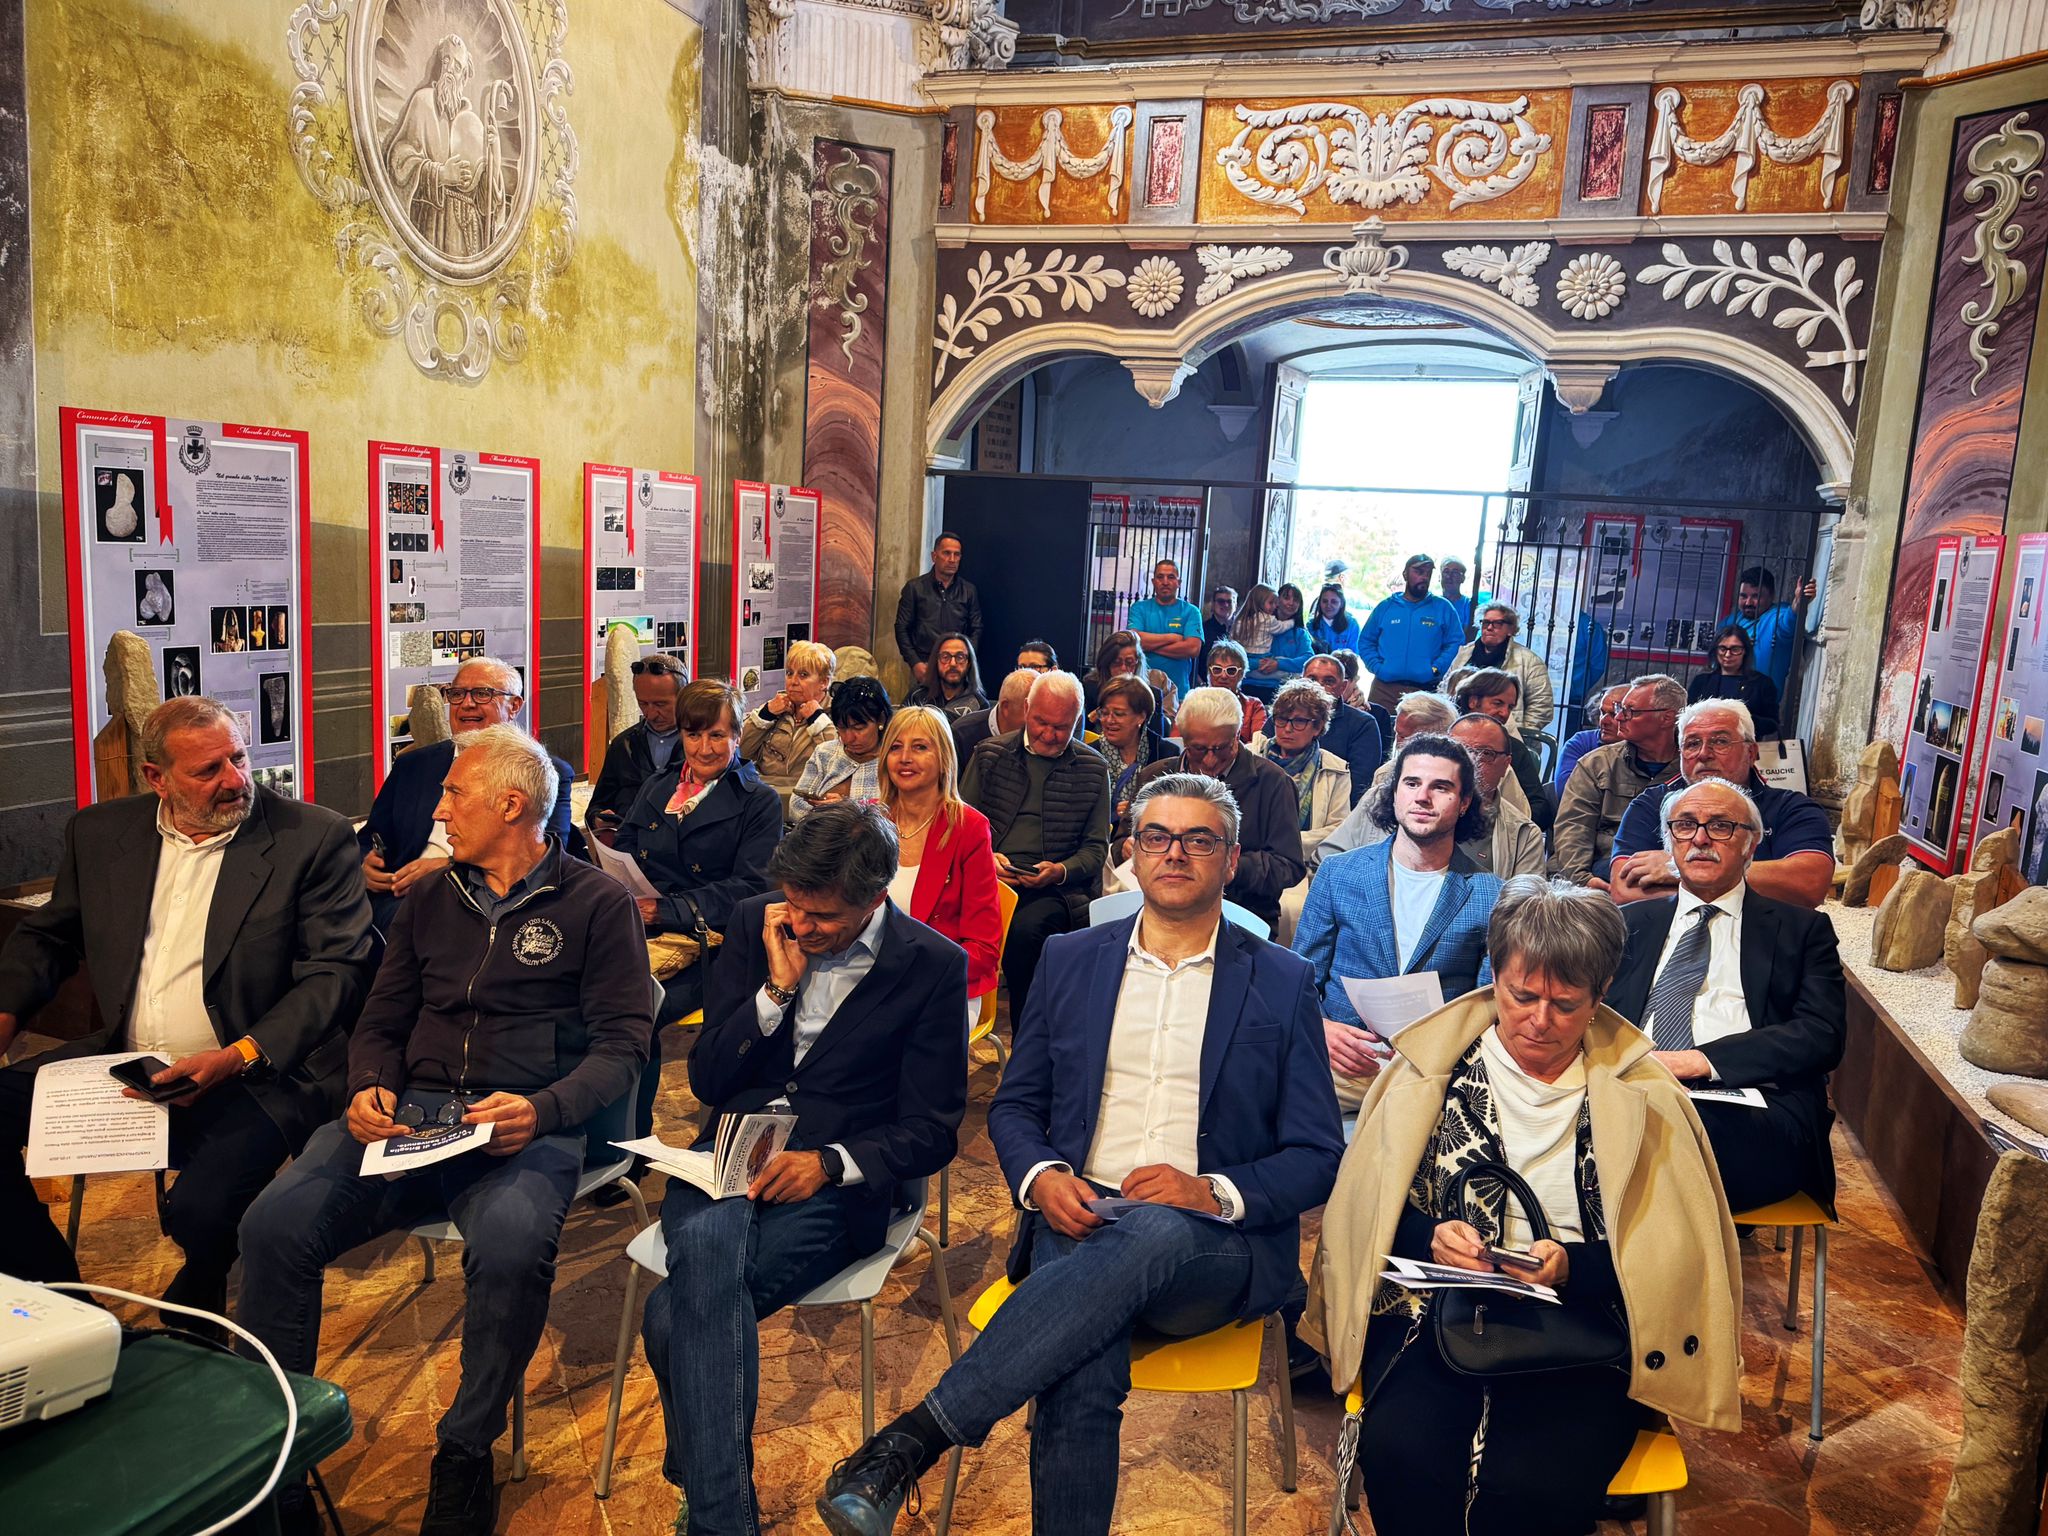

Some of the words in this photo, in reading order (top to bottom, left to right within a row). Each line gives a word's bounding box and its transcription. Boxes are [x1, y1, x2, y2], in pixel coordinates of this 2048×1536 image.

[76, 410, 108, 421] Comune
[109, 414, 117, 422] di
[118, 415, 152, 429] Briaglia
